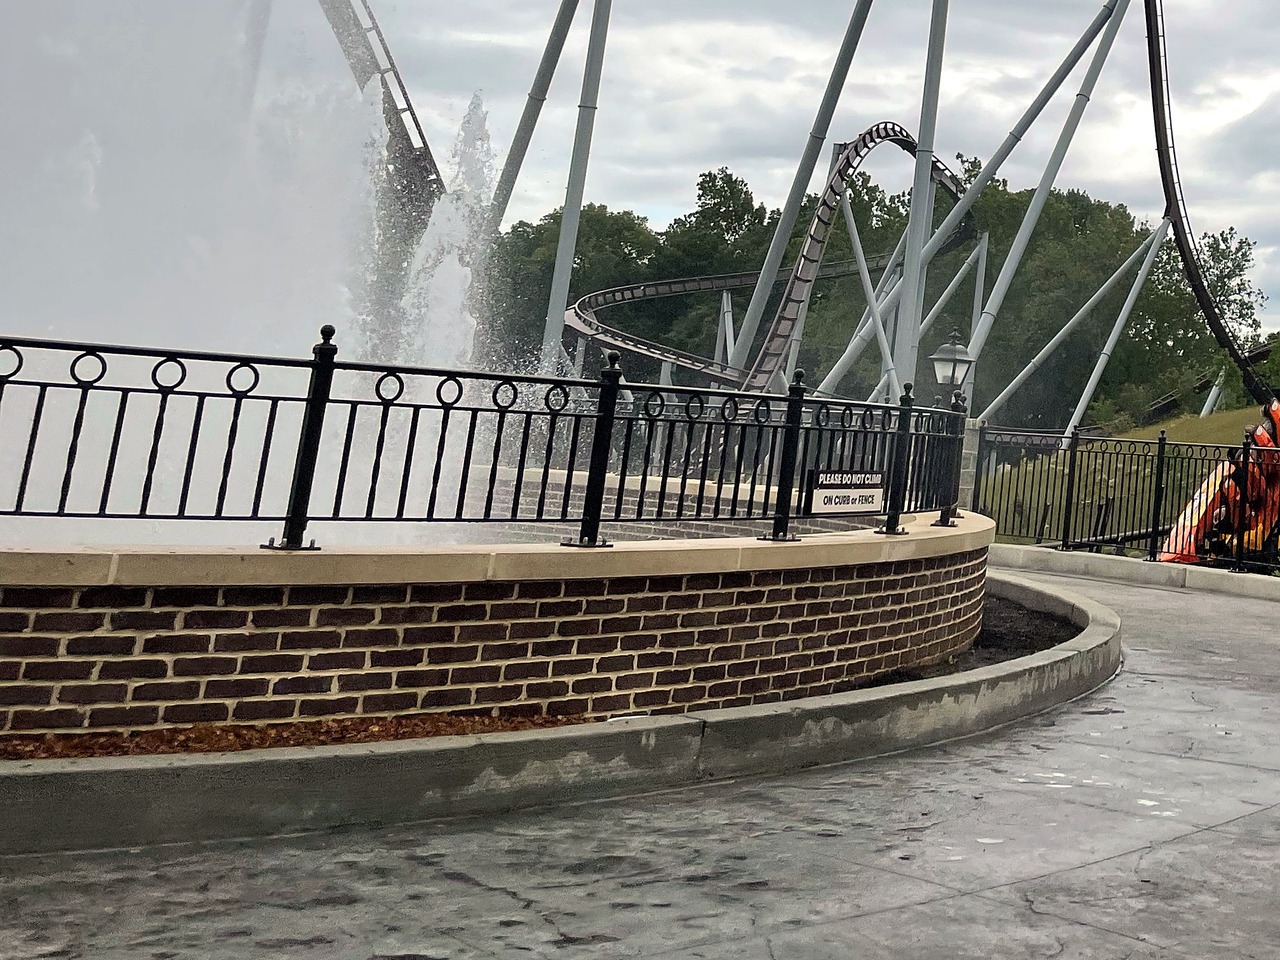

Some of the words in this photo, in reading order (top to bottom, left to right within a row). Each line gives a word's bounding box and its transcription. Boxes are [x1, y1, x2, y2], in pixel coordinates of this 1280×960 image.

[818, 474, 842, 484] PLEASE
[842, 474, 851, 484] DO
[852, 474, 864, 484] NOT
[865, 474, 882, 484] CLIMB
[823, 496, 832, 505] ON
[834, 495, 850, 505] CURB
[858, 495, 875, 504] FENCE
